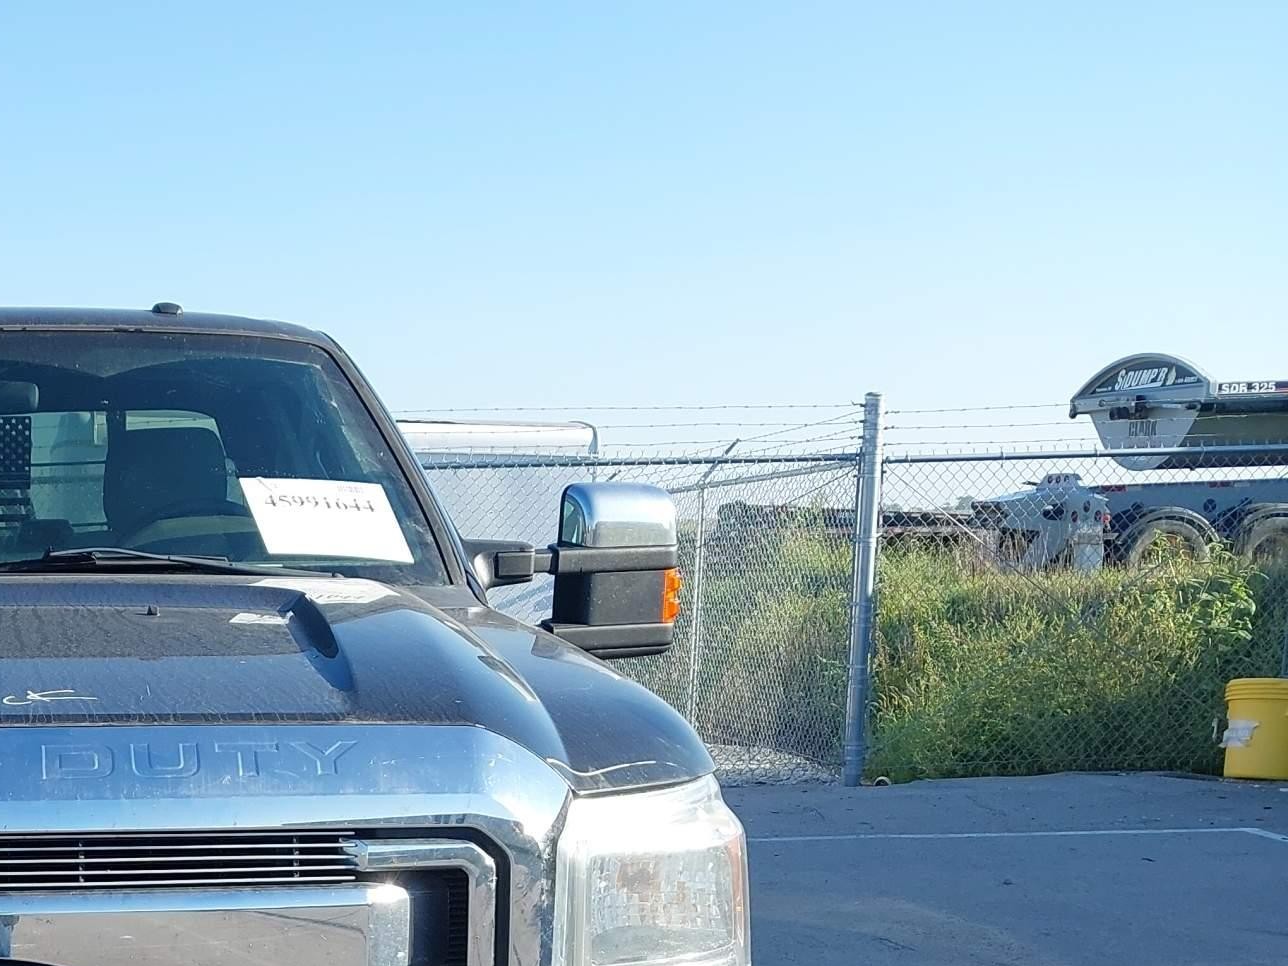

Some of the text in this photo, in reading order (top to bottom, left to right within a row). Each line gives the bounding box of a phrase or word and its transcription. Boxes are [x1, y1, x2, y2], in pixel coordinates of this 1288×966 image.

[1221, 382, 1276, 394] SDR 325
[1128, 420, 1158, 437] CLARK
[40, 740, 359, 781] DUTY
